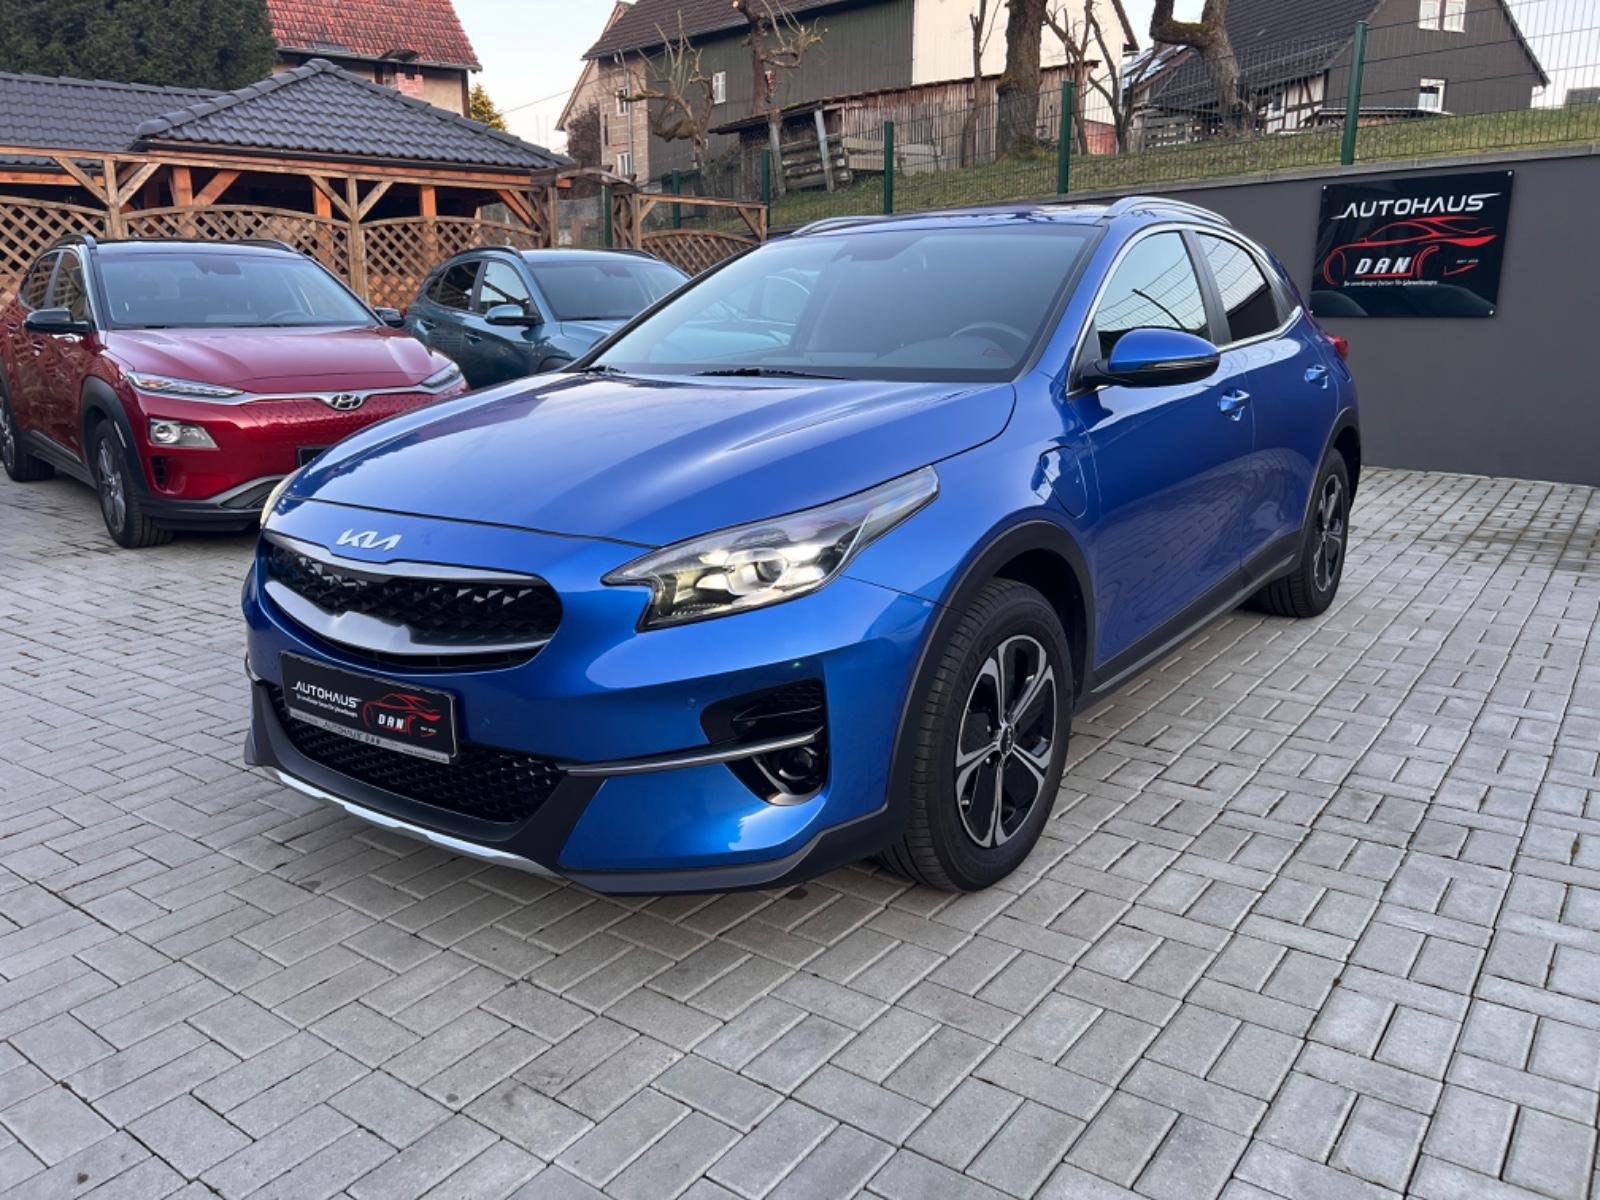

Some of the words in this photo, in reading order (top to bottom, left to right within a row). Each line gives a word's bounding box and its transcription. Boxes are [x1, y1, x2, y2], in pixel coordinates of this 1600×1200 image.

[1330, 192, 1501, 220] AUTOHAUS
[1354, 256, 1412, 275] DAN
[336, 528, 402, 552] KIA
[291, 680, 362, 709] AUTOHAUS
[378, 713, 405, 730] DAN
